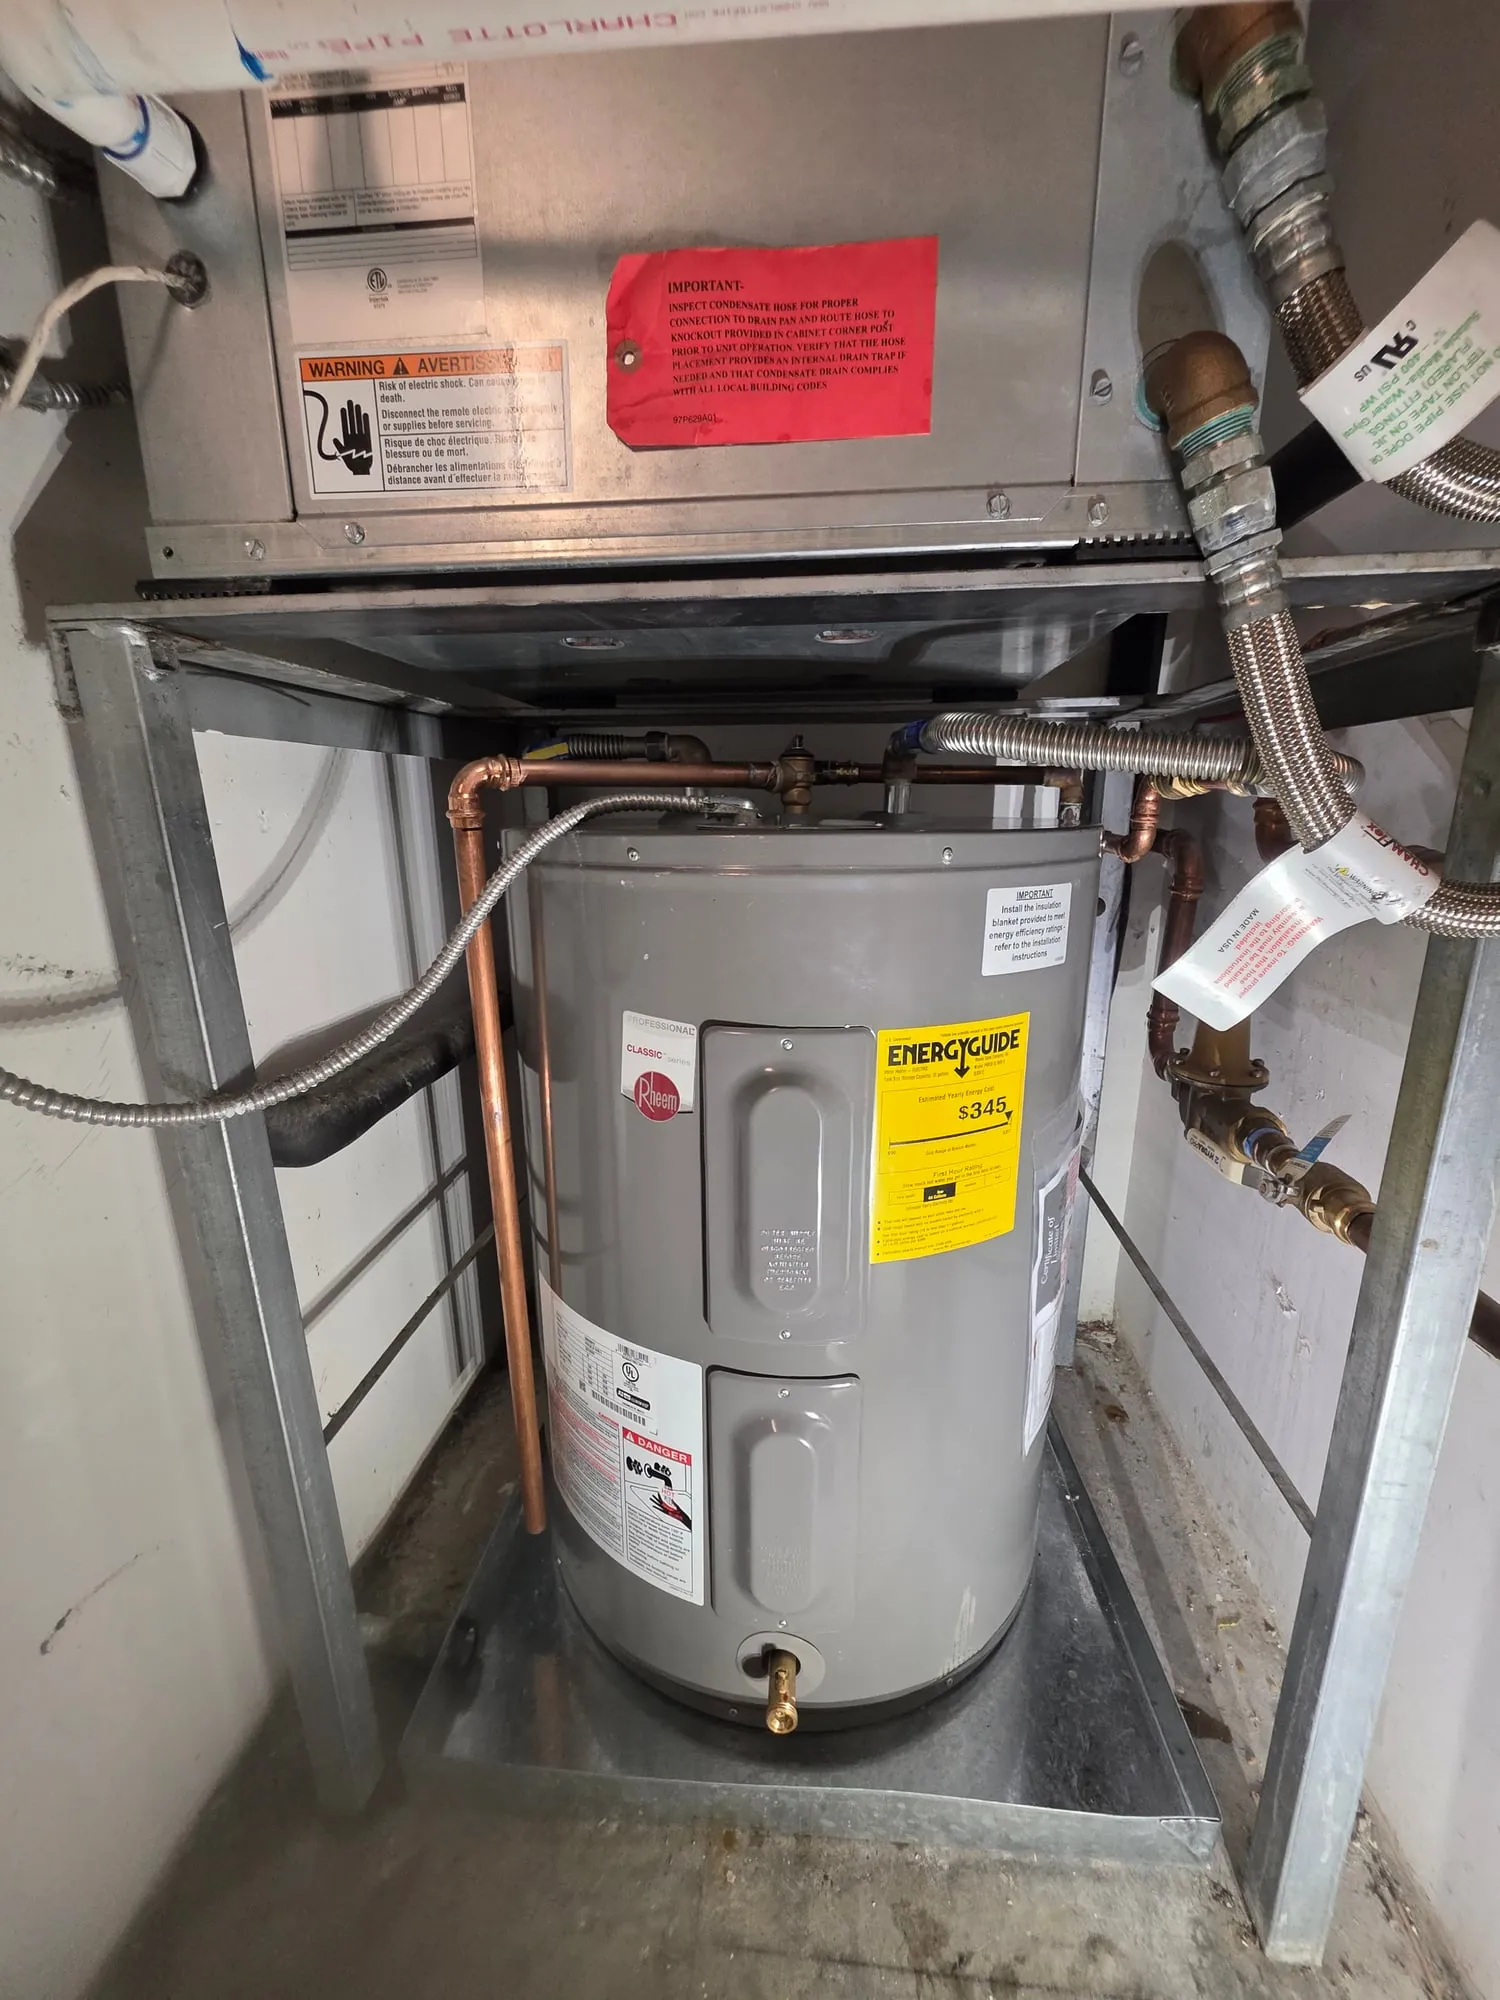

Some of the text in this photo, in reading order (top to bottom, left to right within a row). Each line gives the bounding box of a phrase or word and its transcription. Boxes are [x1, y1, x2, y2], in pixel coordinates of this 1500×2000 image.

[326, 12, 677, 55] CHARLOTTE PIPE
[669, 297, 859, 313] INSPECT CONDENSATE HOSE FOR PROPER
[669, 309, 895, 327] CONNECTION TO DRAIN PAN AND ROUTE HOSE TO
[671, 323, 894, 343] KNOCKOUT PROVIDED IN CABINET CORNER POST
[671, 347, 701, 357] PRIOR
[701, 344, 714, 355] TO
[715, 343, 738, 354] UNIT
[795, 340, 831, 351] VERIFY
[833, 339, 858, 349] THAT
[859, 338, 879, 348] THE
[881, 337, 906, 347] HOSE
[308, 360, 385, 378] WARNING
[672, 351, 908, 370] PLACEMENT PROVIDES AN INTERNAL DRAIN TRAP IF
[1421, 340, 1472, 391] (FLARED)
[1442, 348, 1486, 391] TEFLON
[673, 364, 899, 384] NEEDED AND THAT CONDENSATE DRAIN COMPLIES
[1353, 363, 1373, 383] US
[1359, 351, 1421, 413] 400 PSI WP
[378, 381, 399, 391] Risk
[400, 379, 409, 390] of
[409, 377, 438, 389] electric
[440, 376, 466, 388] shock.
[468, 376, 483, 387] Can
[673, 386, 697, 397] WITH
[698, 384, 715, 394] ALL
[717, 384, 749, 393] LOCAL
[750, 383, 795, 393] BUILDING
[379, 393, 406, 403] death.
[1371, 388, 1406, 418] Water
[1408, 390, 1444, 422] TAPE
[381, 407, 425, 419] Disconnect
[426, 407, 439, 418] the
[441, 407, 470, 416] remote
[1369, 358, 1494, 465] NOT USE PIPE DOPE OR
[383, 417, 495, 431] or supplies before servicing.
[1388, 420, 1409, 437] ON
[384, 432, 493, 449] Risque de choc électrique.
[1372, 434, 1388, 450] JIC
[385, 447, 469, 459] blessure ou de mort.
[386, 462, 433, 473] Débrancher
[435, 462, 448, 472] les
[449, 460, 505, 471] alimentations
[388, 474, 422, 485] distance
[424, 475, 446, 483] avant
[1016, 888, 1054, 900] IMPORTANT
[1001, 901, 1061, 914] Install the insulation
[992, 917, 1019, 927] blanket
[1019, 915, 1046, 926] provided
[988, 927, 1045, 940] energy efficiency
[1217, 908, 1260, 953] MADE IN USA
[1286, 916, 1324, 947] WARNING:
[994, 942, 1011, 952] refer
[1032, 936, 1061, 947] installation
[1011, 950, 1048, 962] instructions
[1213, 928, 1268, 984] to the instructions
[1223, 934, 1274, 988] must be installed
[1254, 955, 1269, 969] this
[1276, 949, 1288, 958] To
[1239, 968, 1256, 985] hose
[1257, 957, 1279, 978] insure
[627, 1015, 695, 1036] PROFESSIONAL
[626, 1044, 663, 1059] CLASSIC
[888, 1029, 1020, 1067] ENERGYGUIDE
[638, 1072, 677, 1113] Rheem
[918, 1092, 946, 1104] Estimated
[947, 1090, 965, 1101] Yearly
[965, 1087, 983, 1098] Energy
[958, 1096, 1007, 1120] $345
[1040, 1216, 1056, 1284] Certificate of
[638, 1434, 689, 1464] DANGER
